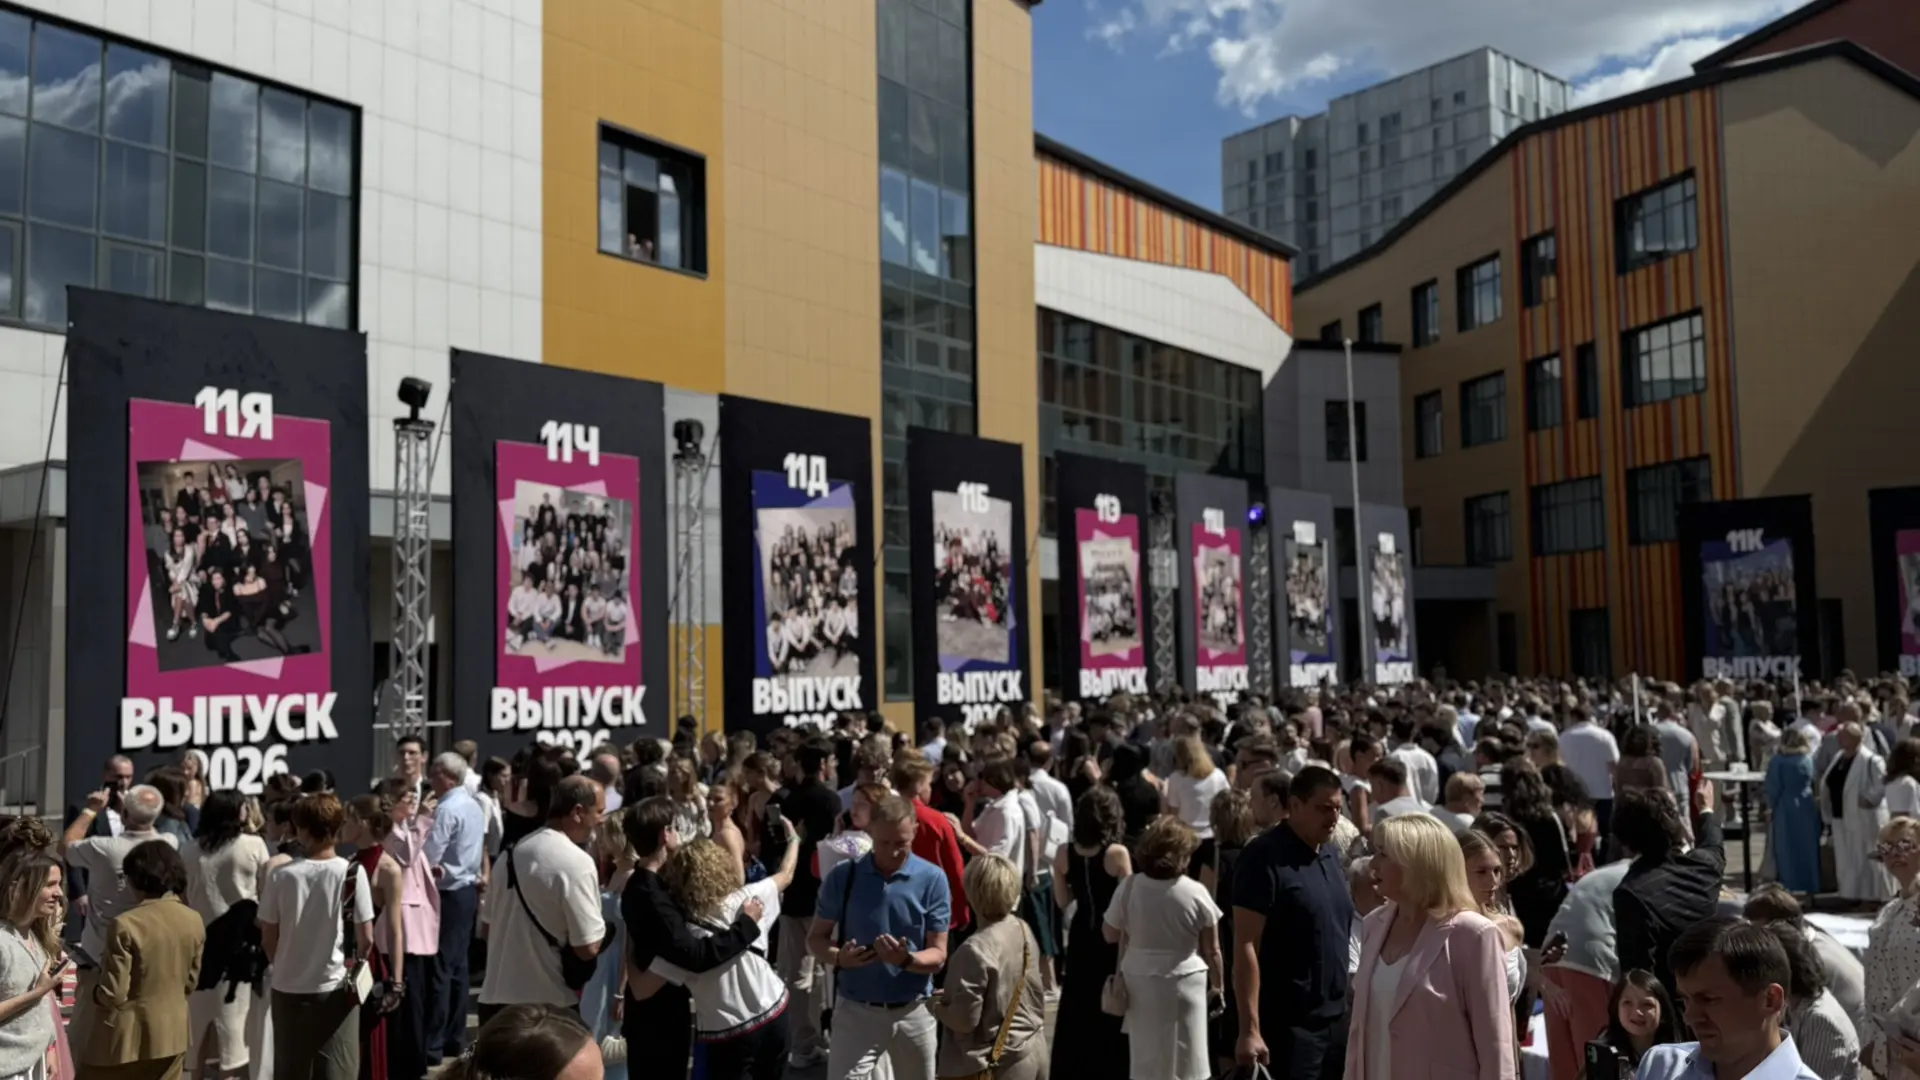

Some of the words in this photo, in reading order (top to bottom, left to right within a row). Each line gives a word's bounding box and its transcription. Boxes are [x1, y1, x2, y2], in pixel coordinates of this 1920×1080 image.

[195, 386, 273, 441] 11Я
[541, 420, 600, 466] 11Ч
[783, 452, 829, 498] 11Д
[957, 480, 990, 513] 11Б
[1726, 528, 1765, 553] 11К
[936, 670, 1023, 704] ВЫПУСК
[1702, 655, 1803, 678] ВЫПУСК
[490, 685, 647, 730] ВЫПУСК
[752, 676, 862, 715] ВЫПУСК
[121, 692, 338, 749] ВЫПУСК
